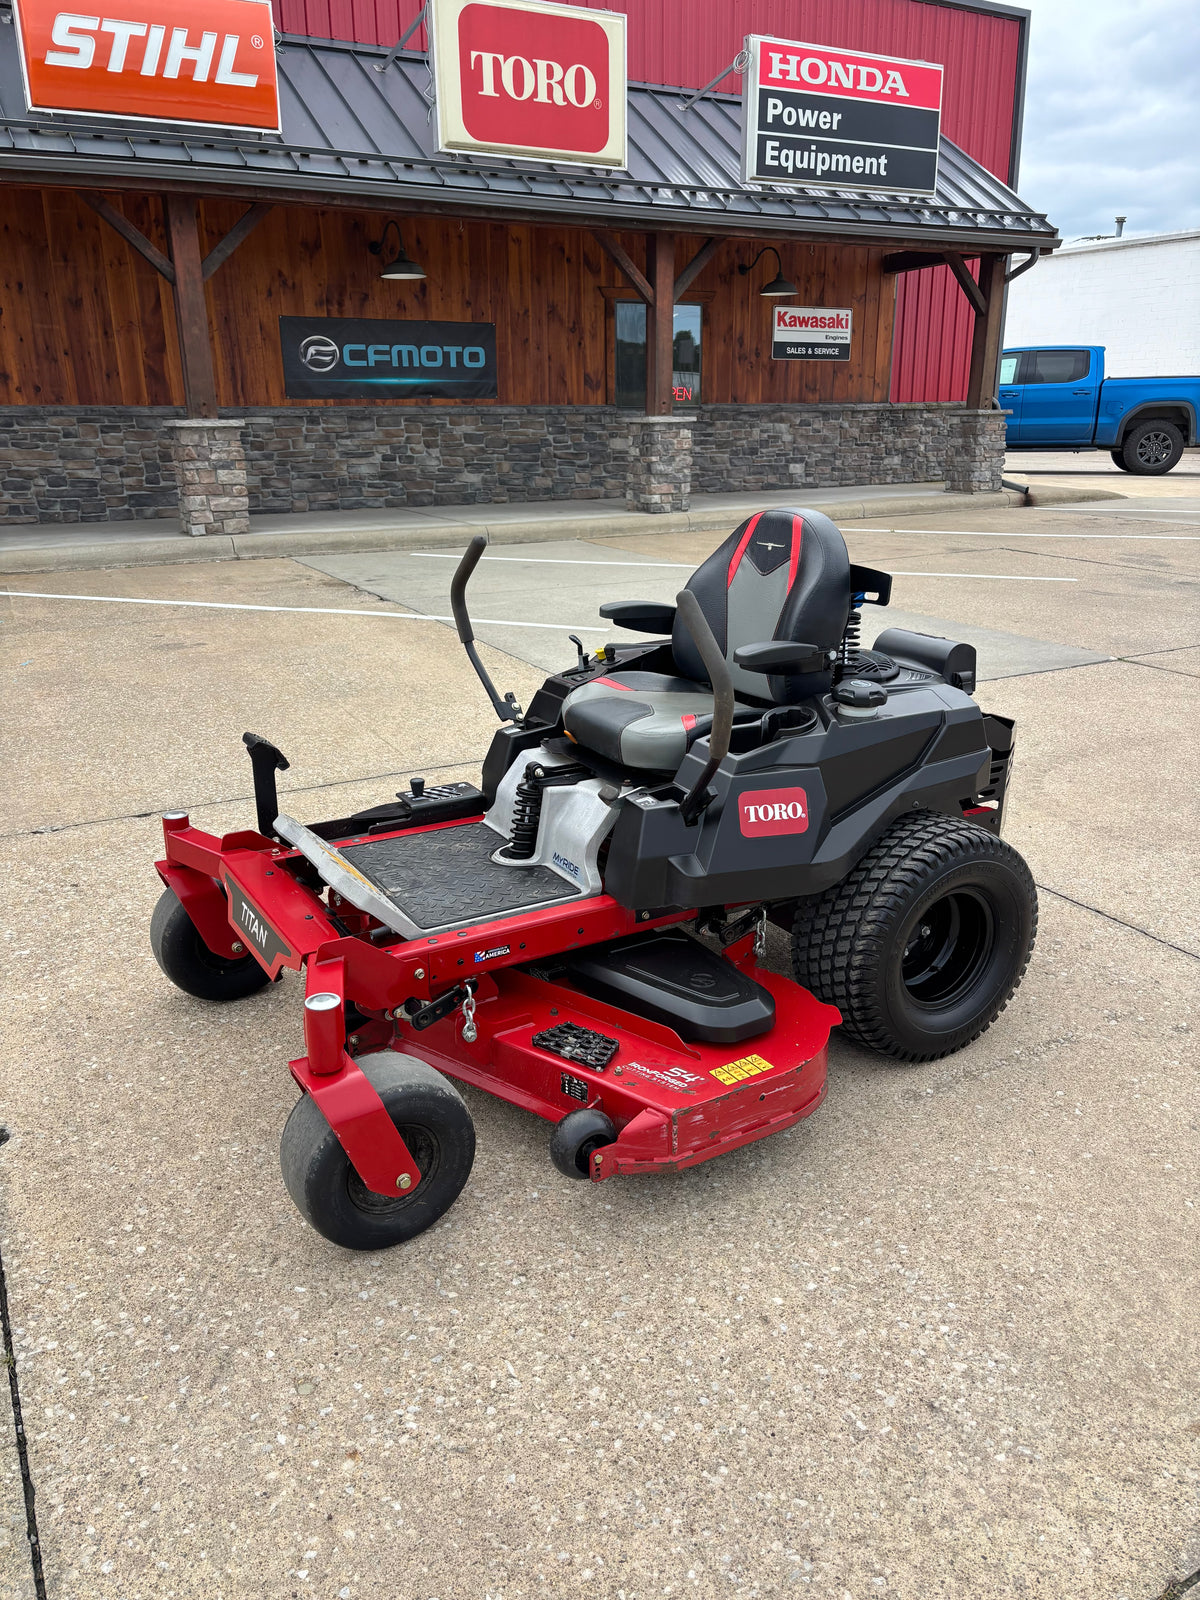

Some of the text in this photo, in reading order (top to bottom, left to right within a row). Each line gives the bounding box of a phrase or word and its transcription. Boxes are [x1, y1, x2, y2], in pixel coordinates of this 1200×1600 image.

[44, 12, 259, 88] STIHL
[470, 50, 597, 109] TORO
[768, 52, 910, 97] HONDA
[766, 97, 842, 130] Power
[765, 140, 888, 176] Equipment
[776, 311, 850, 329] Kawasaki
[342, 343, 486, 368] CFMOTO
[786, 346, 840, 356] SALES & SERVICE
[671, 386, 693, 401] PEN
[744, 801, 803, 823] TORO
[241, 901, 268, 949] TITAN
[485, 948, 511, 960] AMERICA
[627, 1062, 688, 1088] IRONFORGED
